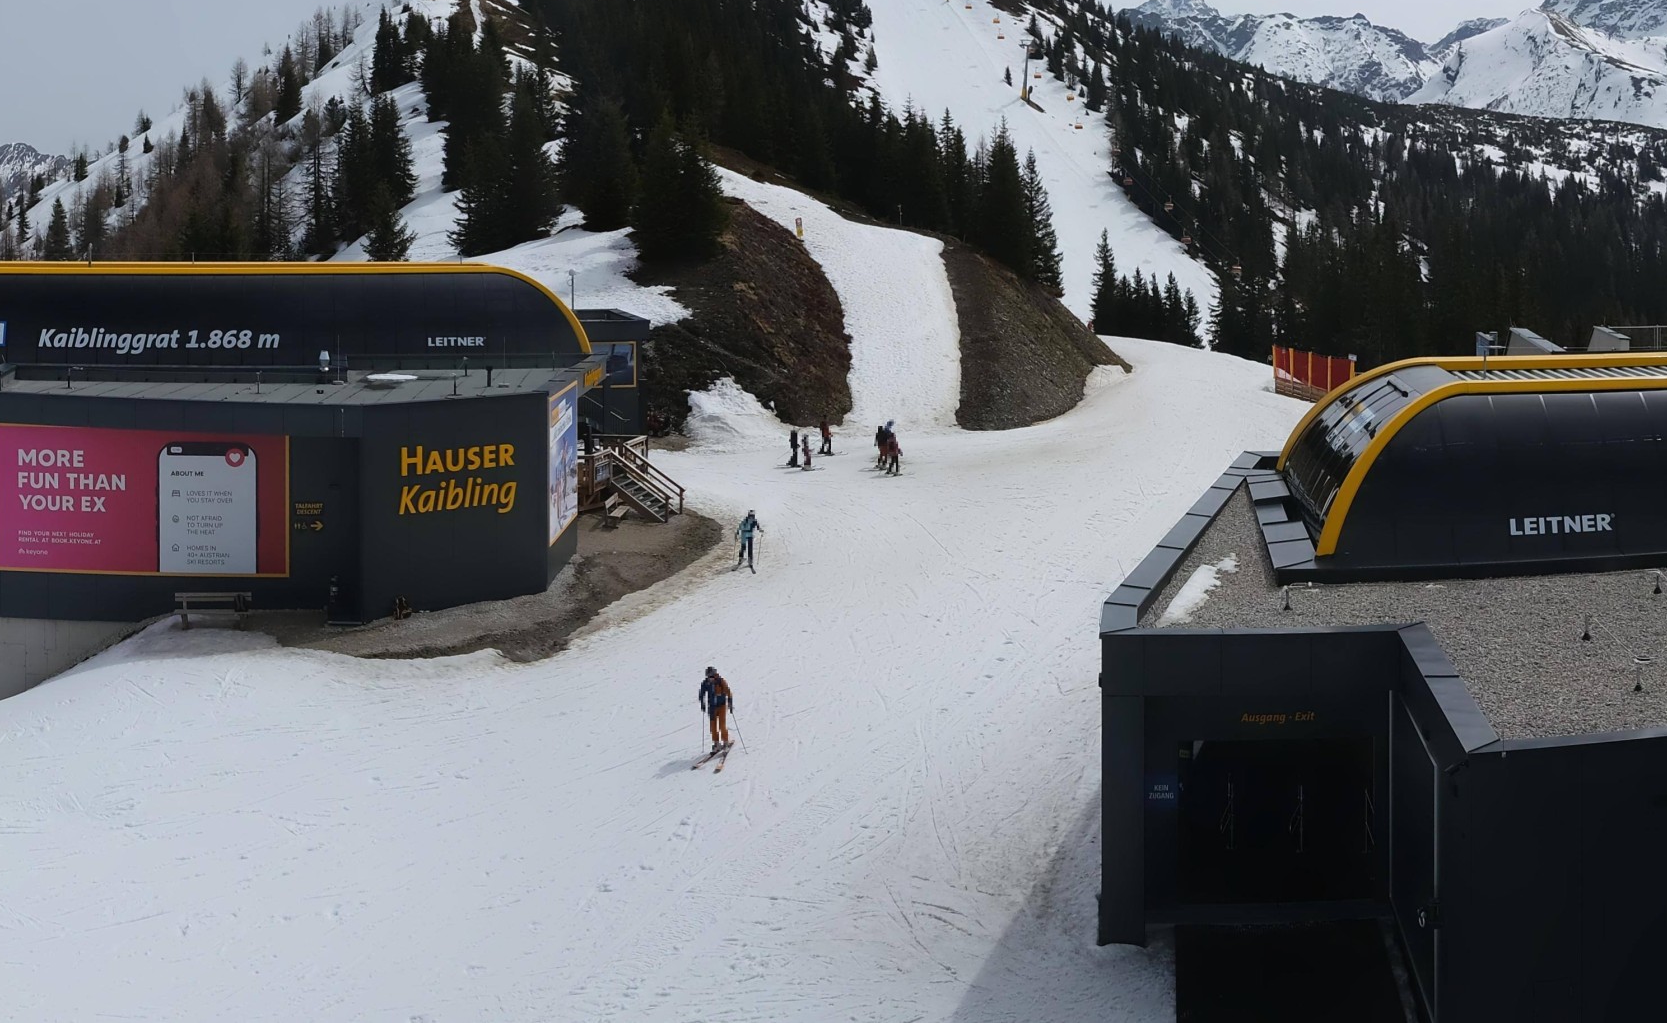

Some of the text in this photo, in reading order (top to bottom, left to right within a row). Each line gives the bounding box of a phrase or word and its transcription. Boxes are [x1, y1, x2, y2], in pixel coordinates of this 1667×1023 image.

[38, 328, 280, 354] Kaiblinggrat 1.868 m
[427, 337, 485, 347] LEITNER
[17, 449, 85, 468] MORE
[401, 443, 515, 477] HAUSER
[17, 472, 126, 491] FUN THAN
[19, 494, 106, 513] YOUR EX
[398, 477, 517, 515] Kaibling
[1509, 513, 1613, 536] LEITNER
[1241, 712, 1286, 724] Ausgang
[1295, 711, 1315, 721] Exit
[1148, 792, 1174, 800] ZUGANG
[1154, 784, 1169, 792] KEIN
